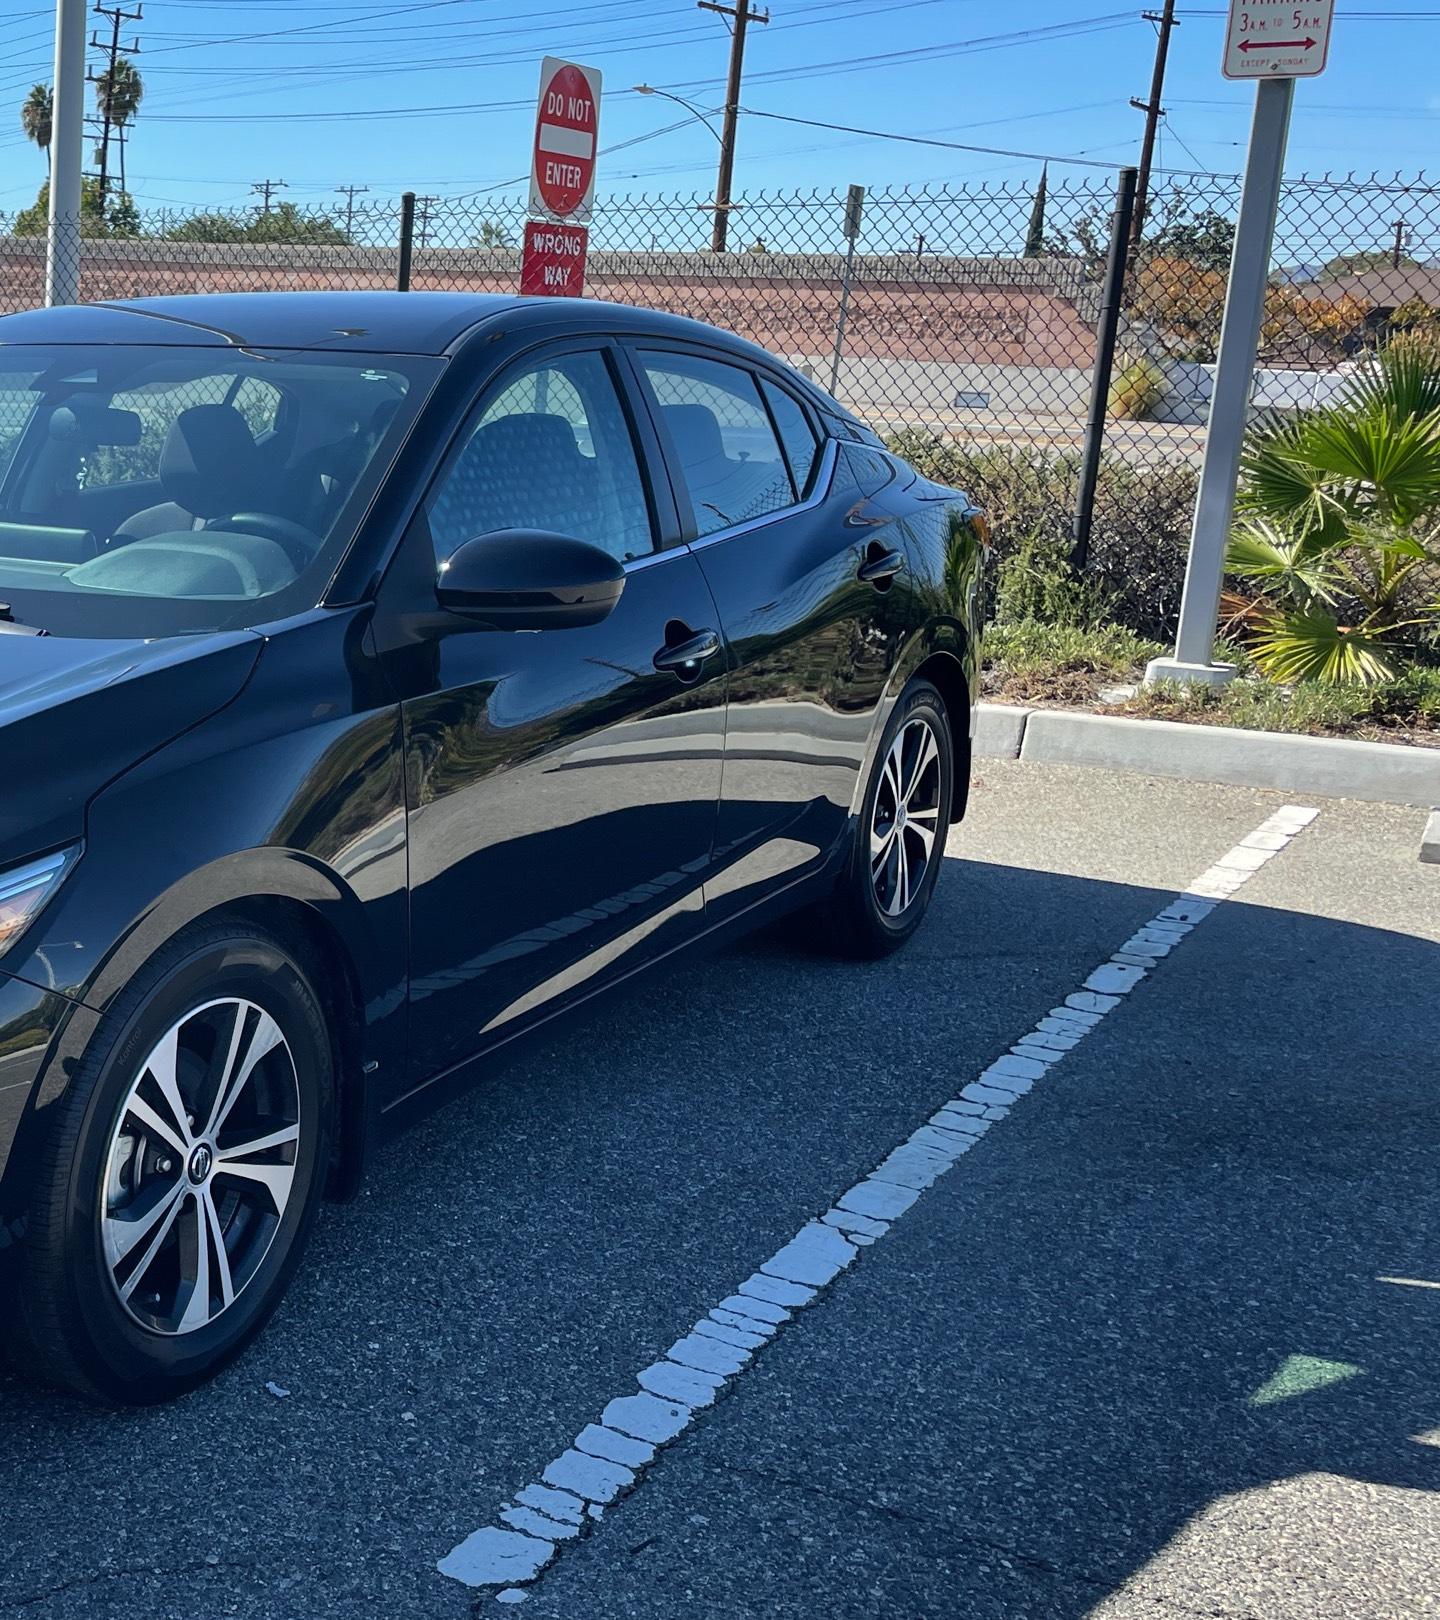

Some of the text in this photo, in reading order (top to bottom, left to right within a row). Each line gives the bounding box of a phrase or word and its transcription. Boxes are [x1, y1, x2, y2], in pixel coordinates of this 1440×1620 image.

[1240, 59, 1270, 67] EXCEPT
[548, 92, 591, 122] DO NOT
[545, 161, 581, 189] ENTER
[533, 232, 581, 257] WRONG
[544, 265, 572, 287] WAY
